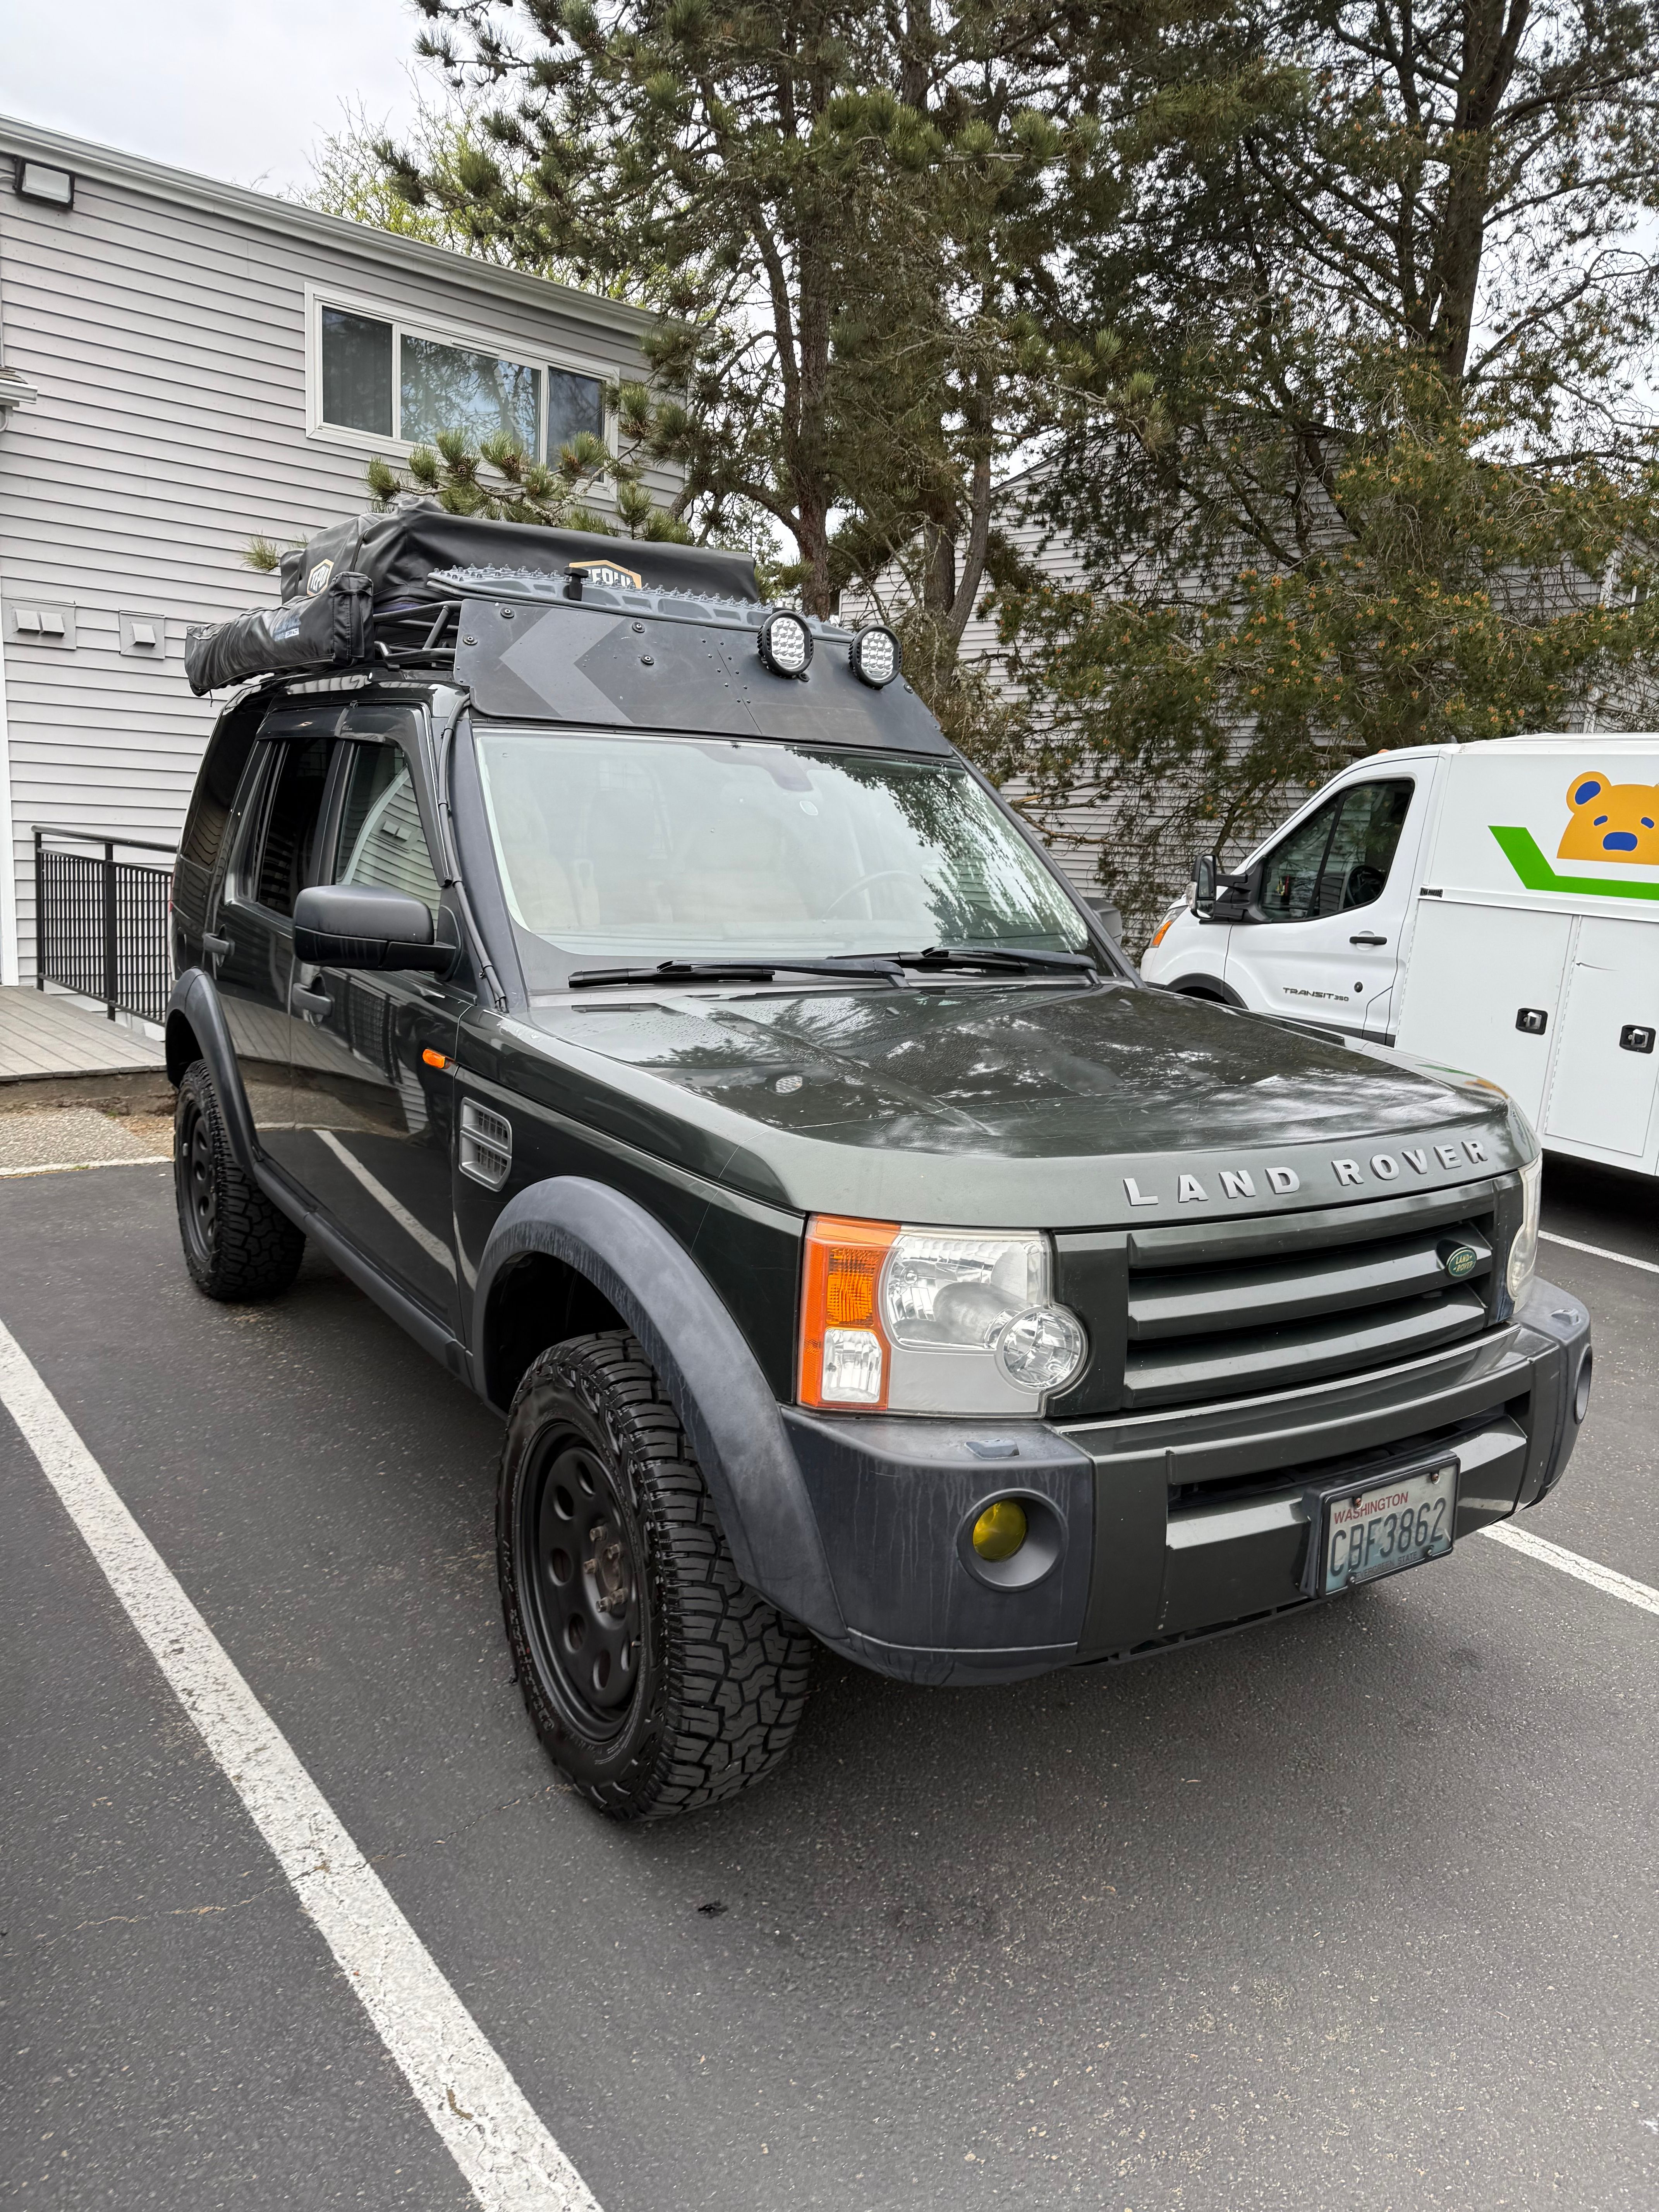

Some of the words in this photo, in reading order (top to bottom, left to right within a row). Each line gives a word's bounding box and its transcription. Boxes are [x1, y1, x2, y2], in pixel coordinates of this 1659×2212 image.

[1283, 988, 1334, 999] TRANSIT
[1123, 1167, 1300, 1206] LAND
[1331, 1139, 1487, 1186] ROVER
[1334, 1492, 1408, 1524] WASHINGTON
[1330, 1498, 1446, 1576] CBF3862
[1398, 1551, 1417, 1564] STATE
